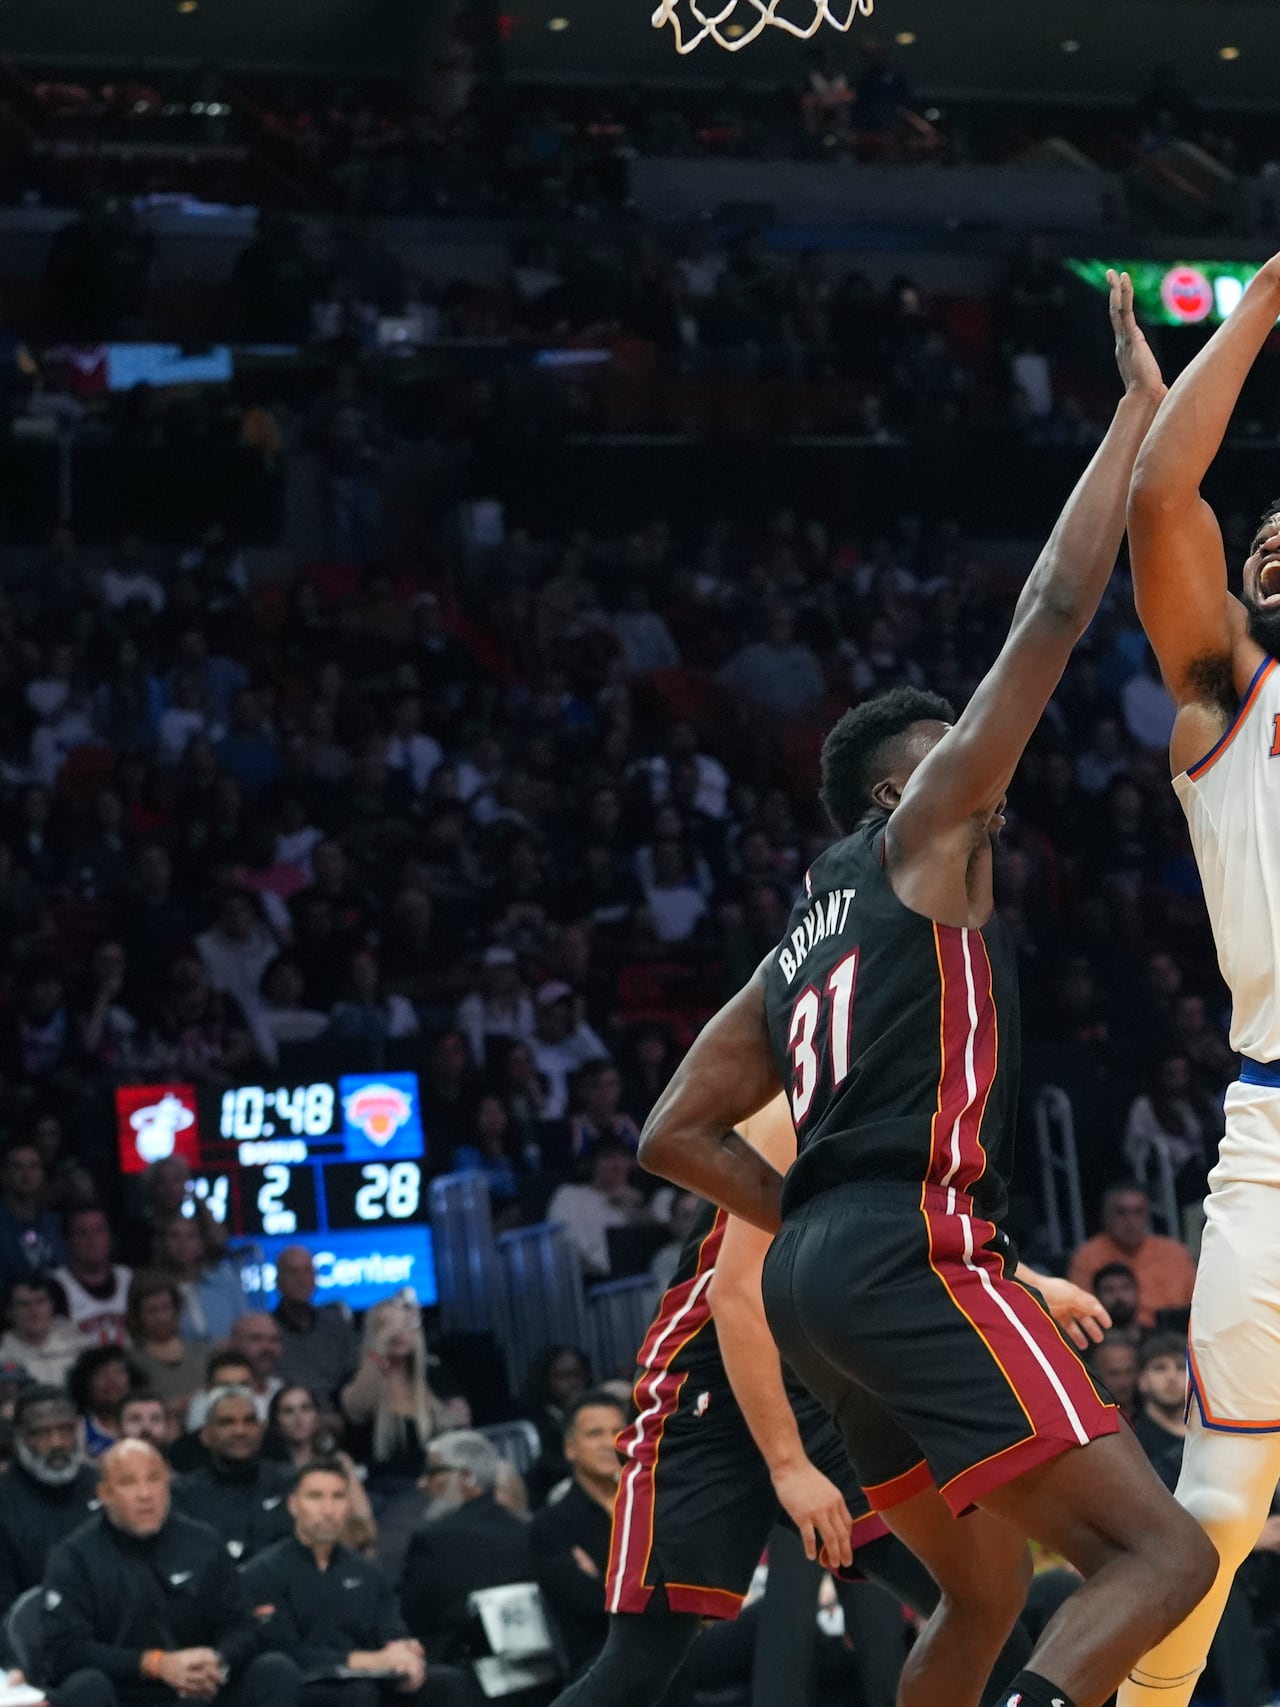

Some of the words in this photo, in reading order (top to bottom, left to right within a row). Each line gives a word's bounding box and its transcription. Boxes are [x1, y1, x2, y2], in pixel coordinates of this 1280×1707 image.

[778, 888, 856, 985] BRYANT
[786, 945, 860, 1128] 31
[220, 1083, 334, 1139] 10:48
[257, 1165, 291, 1214] 2
[355, 1162, 420, 1220] 28
[311, 1252, 415, 1289] Center
